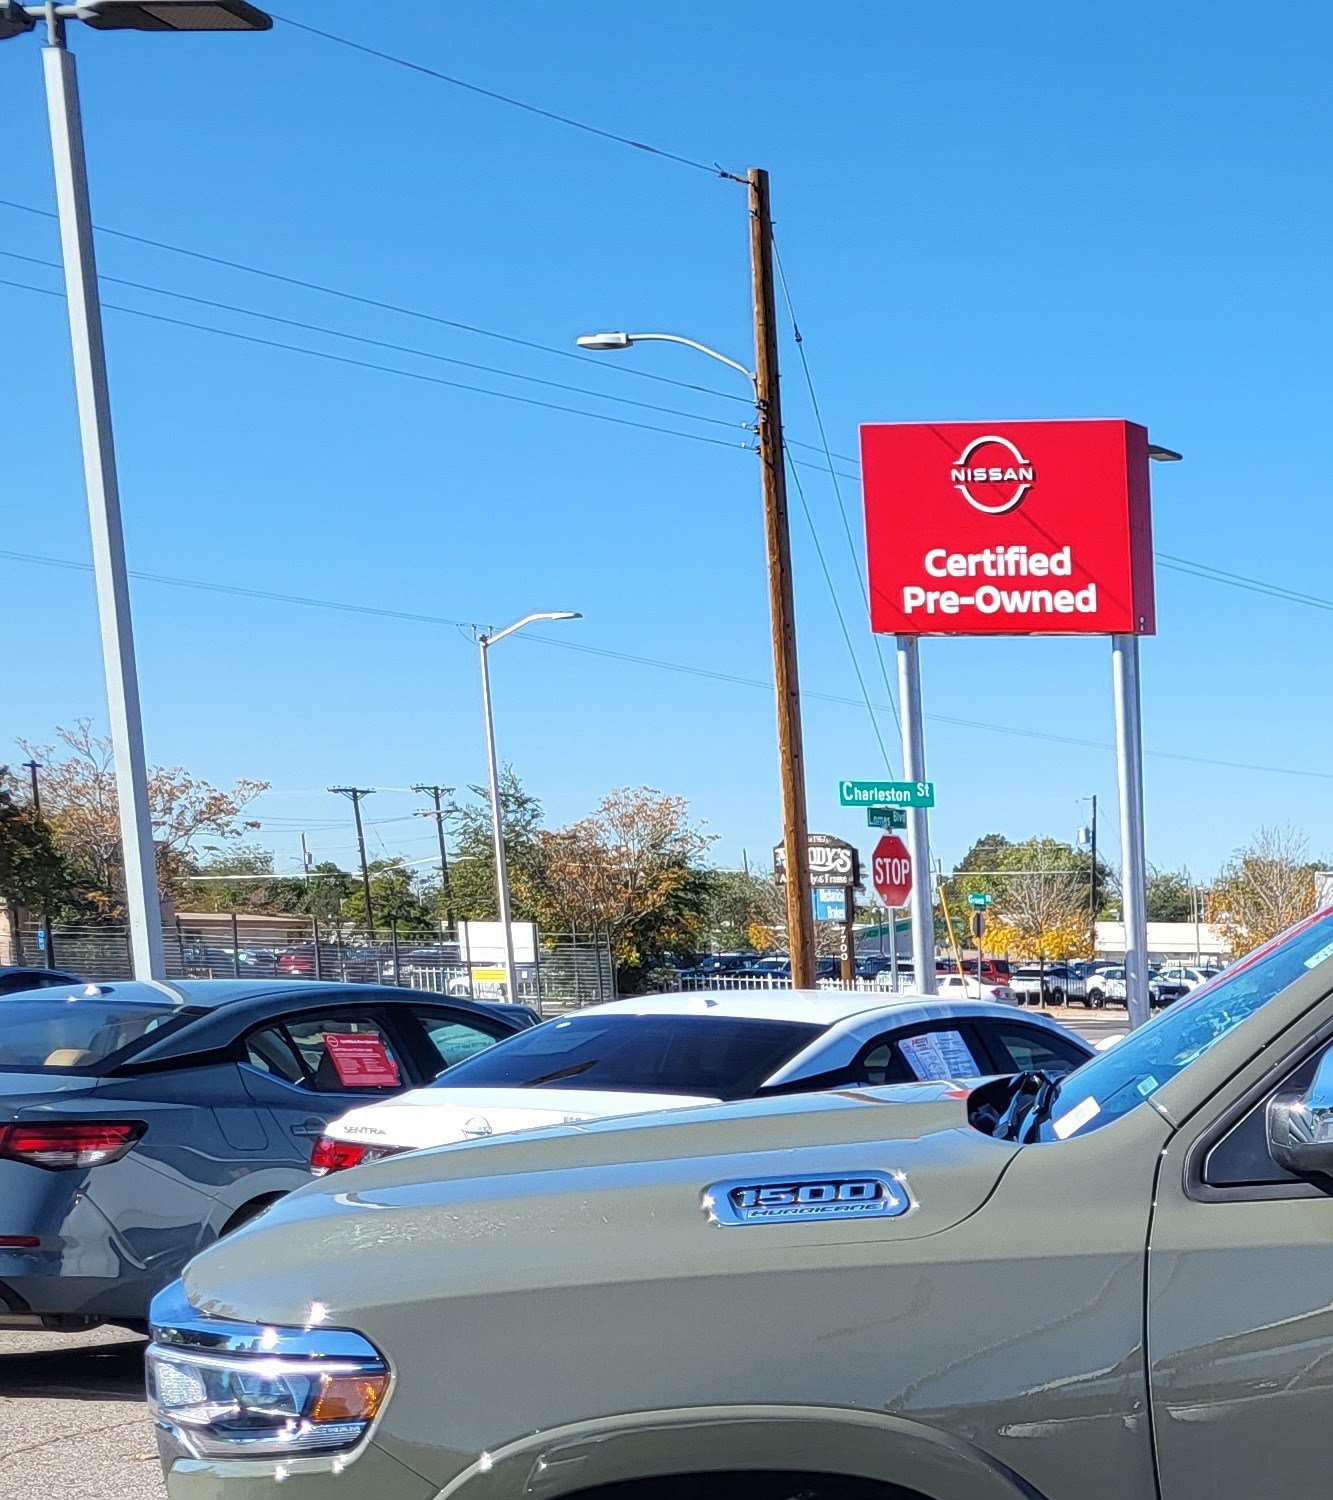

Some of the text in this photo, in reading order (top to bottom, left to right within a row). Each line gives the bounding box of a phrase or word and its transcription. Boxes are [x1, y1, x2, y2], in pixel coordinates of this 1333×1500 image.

[951, 467, 1034, 482] NISSAN
[924, 545, 1072, 577] Certified
[902, 583, 1098, 614] Pre-Owned
[842, 782, 930, 802] Charleston St
[874, 857, 911, 885] STOP
[344, 1126, 387, 1136] SENTRA
[736, 1182, 877, 1208] 1500
[750, 1203, 880, 1217] HURRICANE
